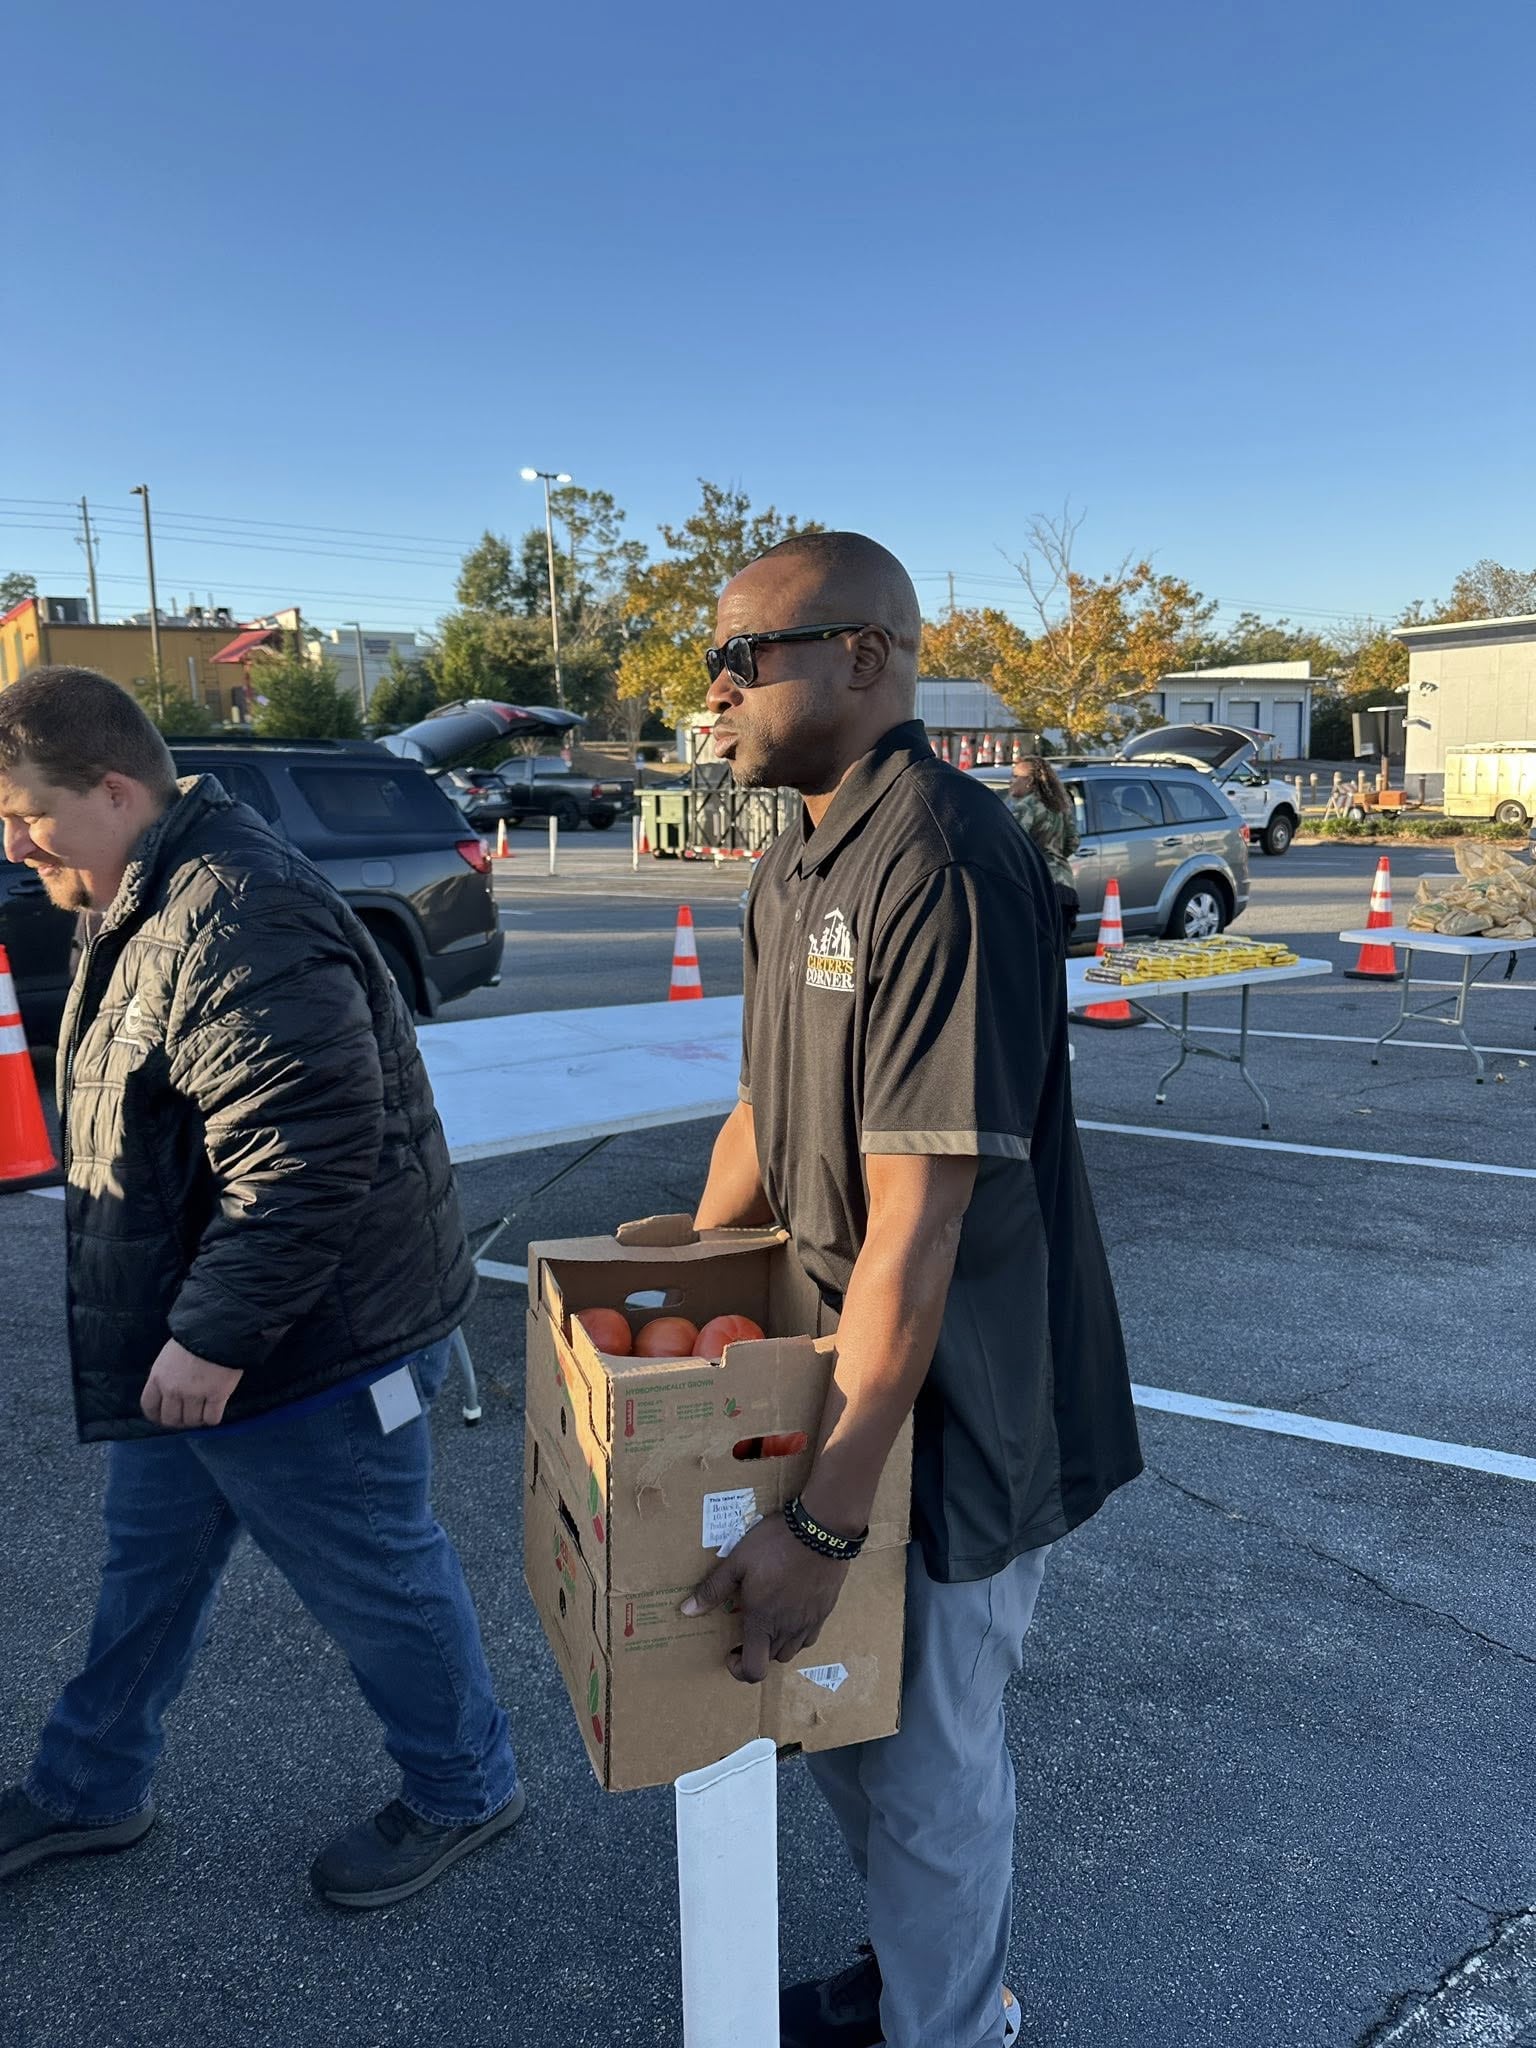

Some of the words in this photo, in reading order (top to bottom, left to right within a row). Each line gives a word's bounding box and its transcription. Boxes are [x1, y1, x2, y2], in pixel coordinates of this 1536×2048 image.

[807, 955, 854, 975] CARTER'S
[806, 967, 855, 988] CORNER
[625, 1383, 685, 1396] HYDROPONICALLY
[687, 1379, 714, 1389] GROWN
